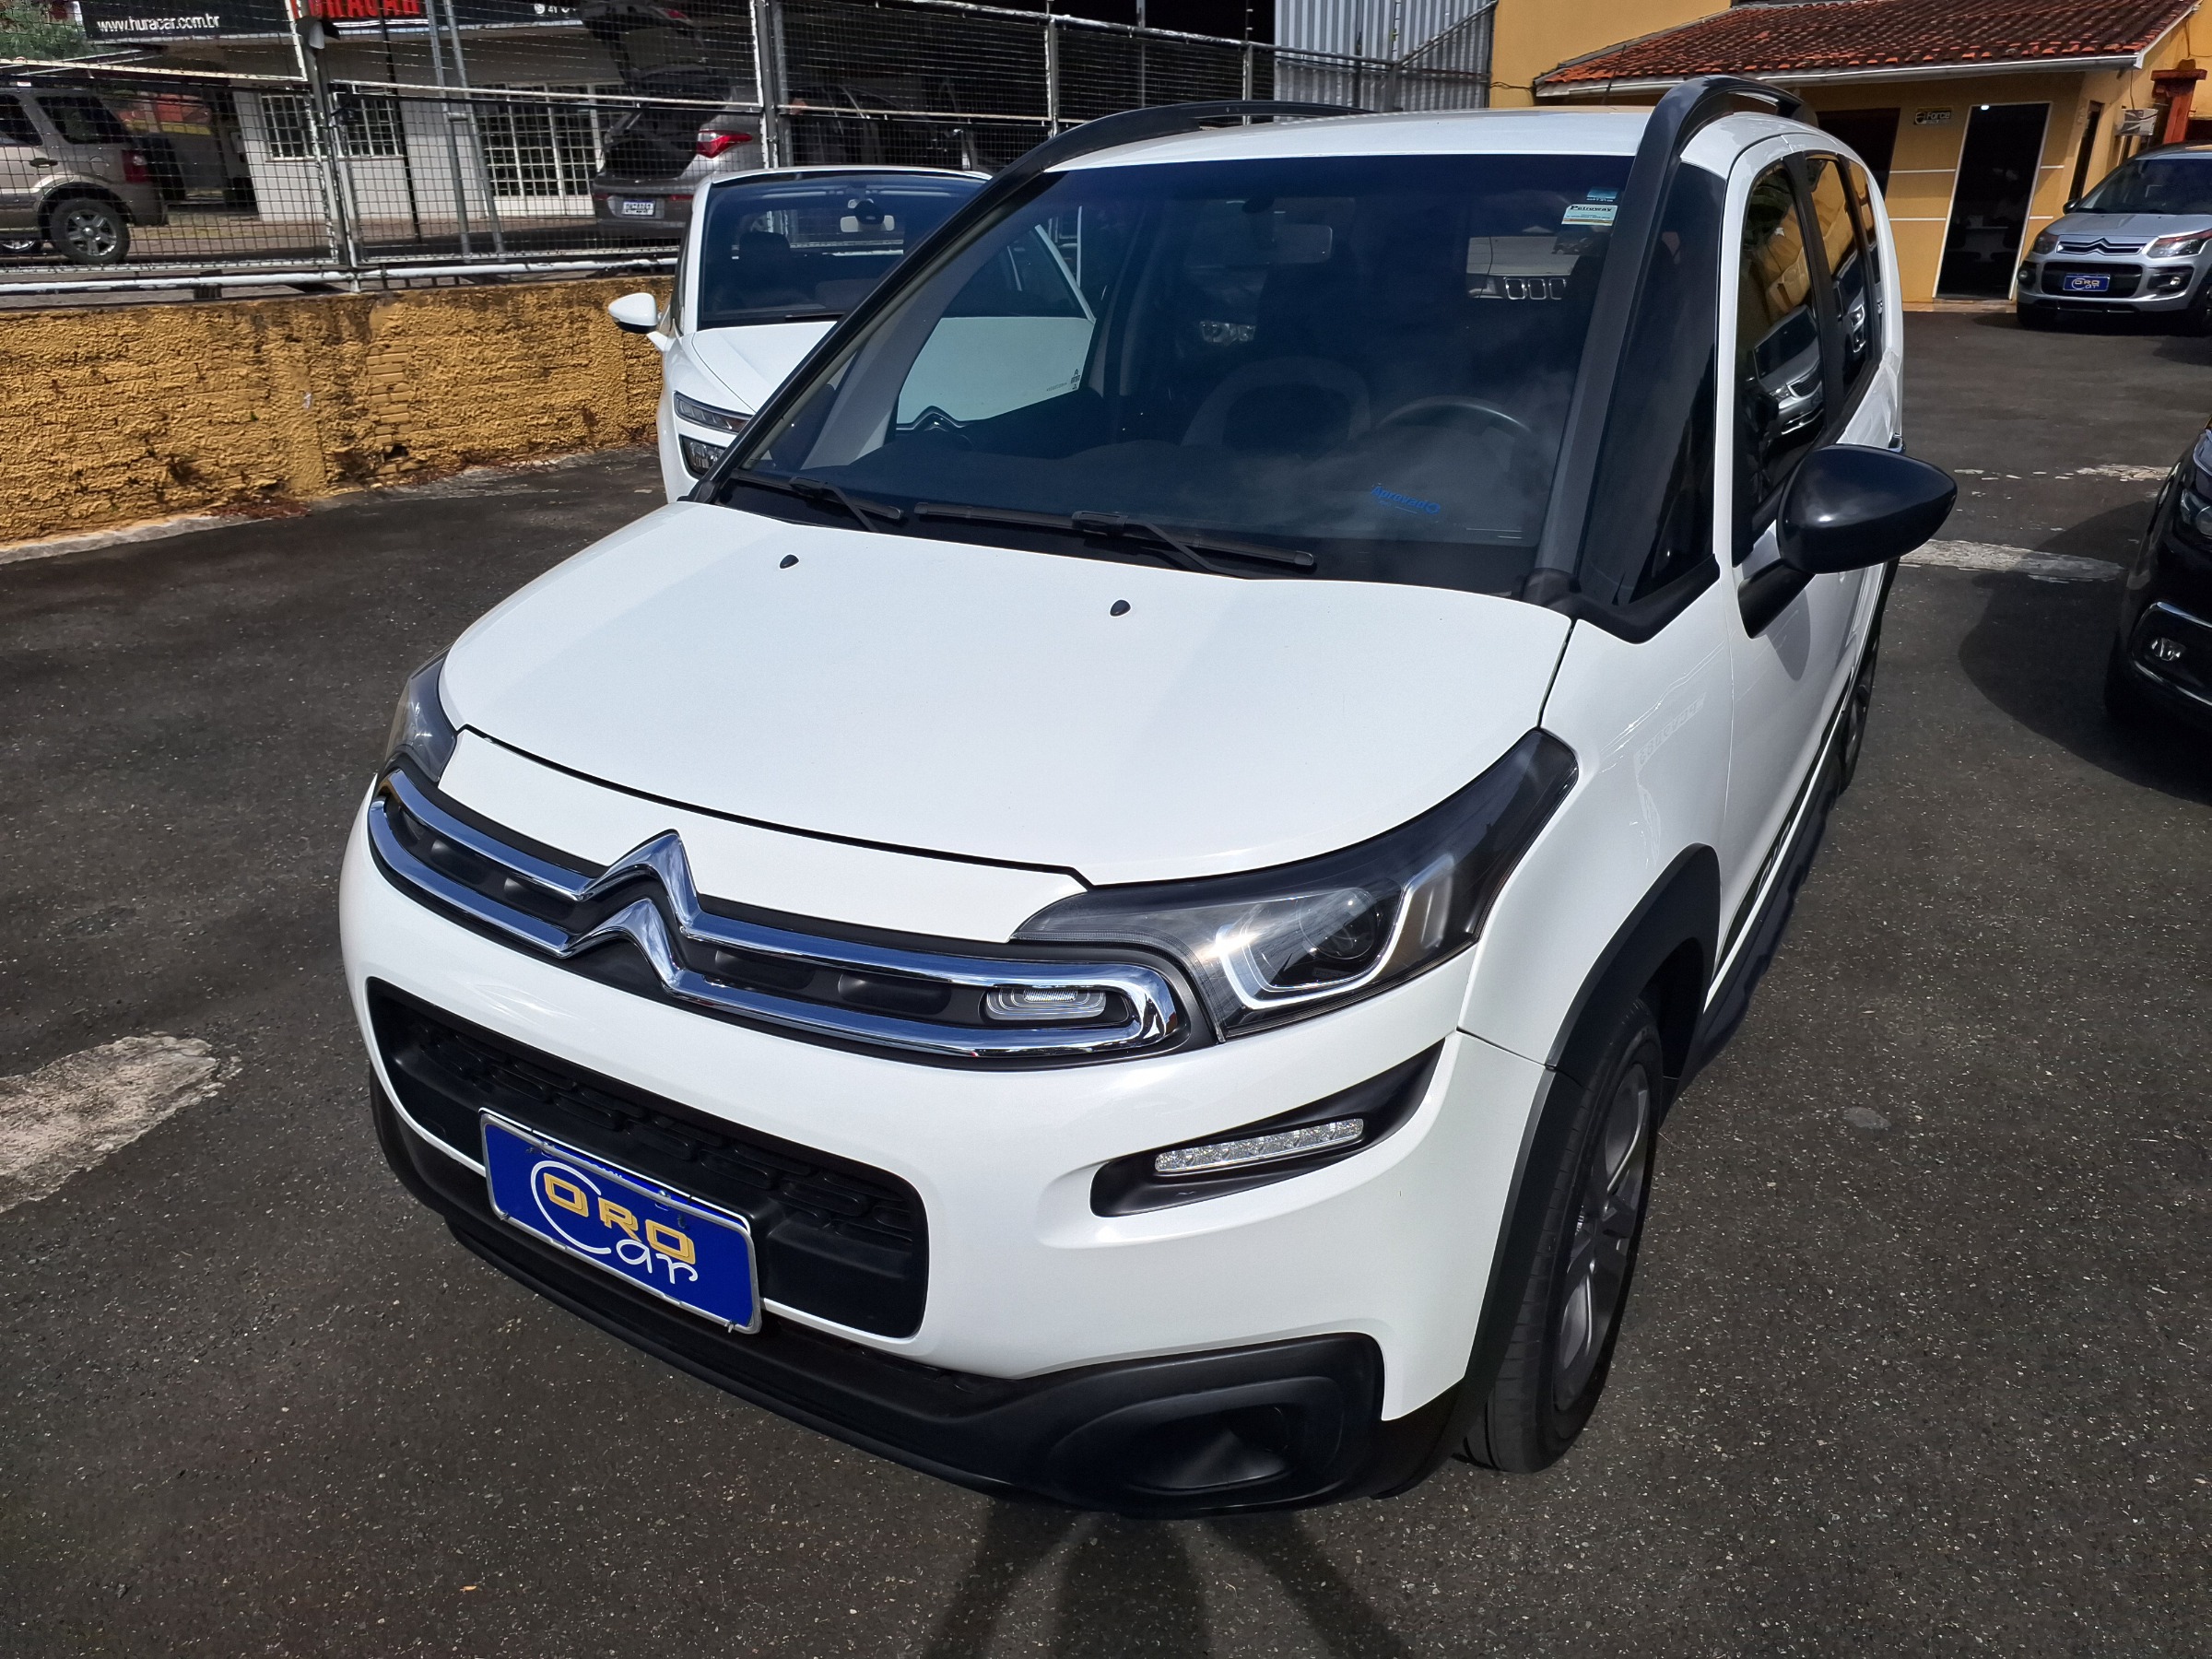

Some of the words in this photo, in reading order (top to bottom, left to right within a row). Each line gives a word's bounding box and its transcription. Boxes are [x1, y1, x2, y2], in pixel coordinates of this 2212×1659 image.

[97, 13, 220, 33] www.huracar.com.br
[530, 1160, 699, 1285] Car
[543, 1172, 696, 1265] ORO
